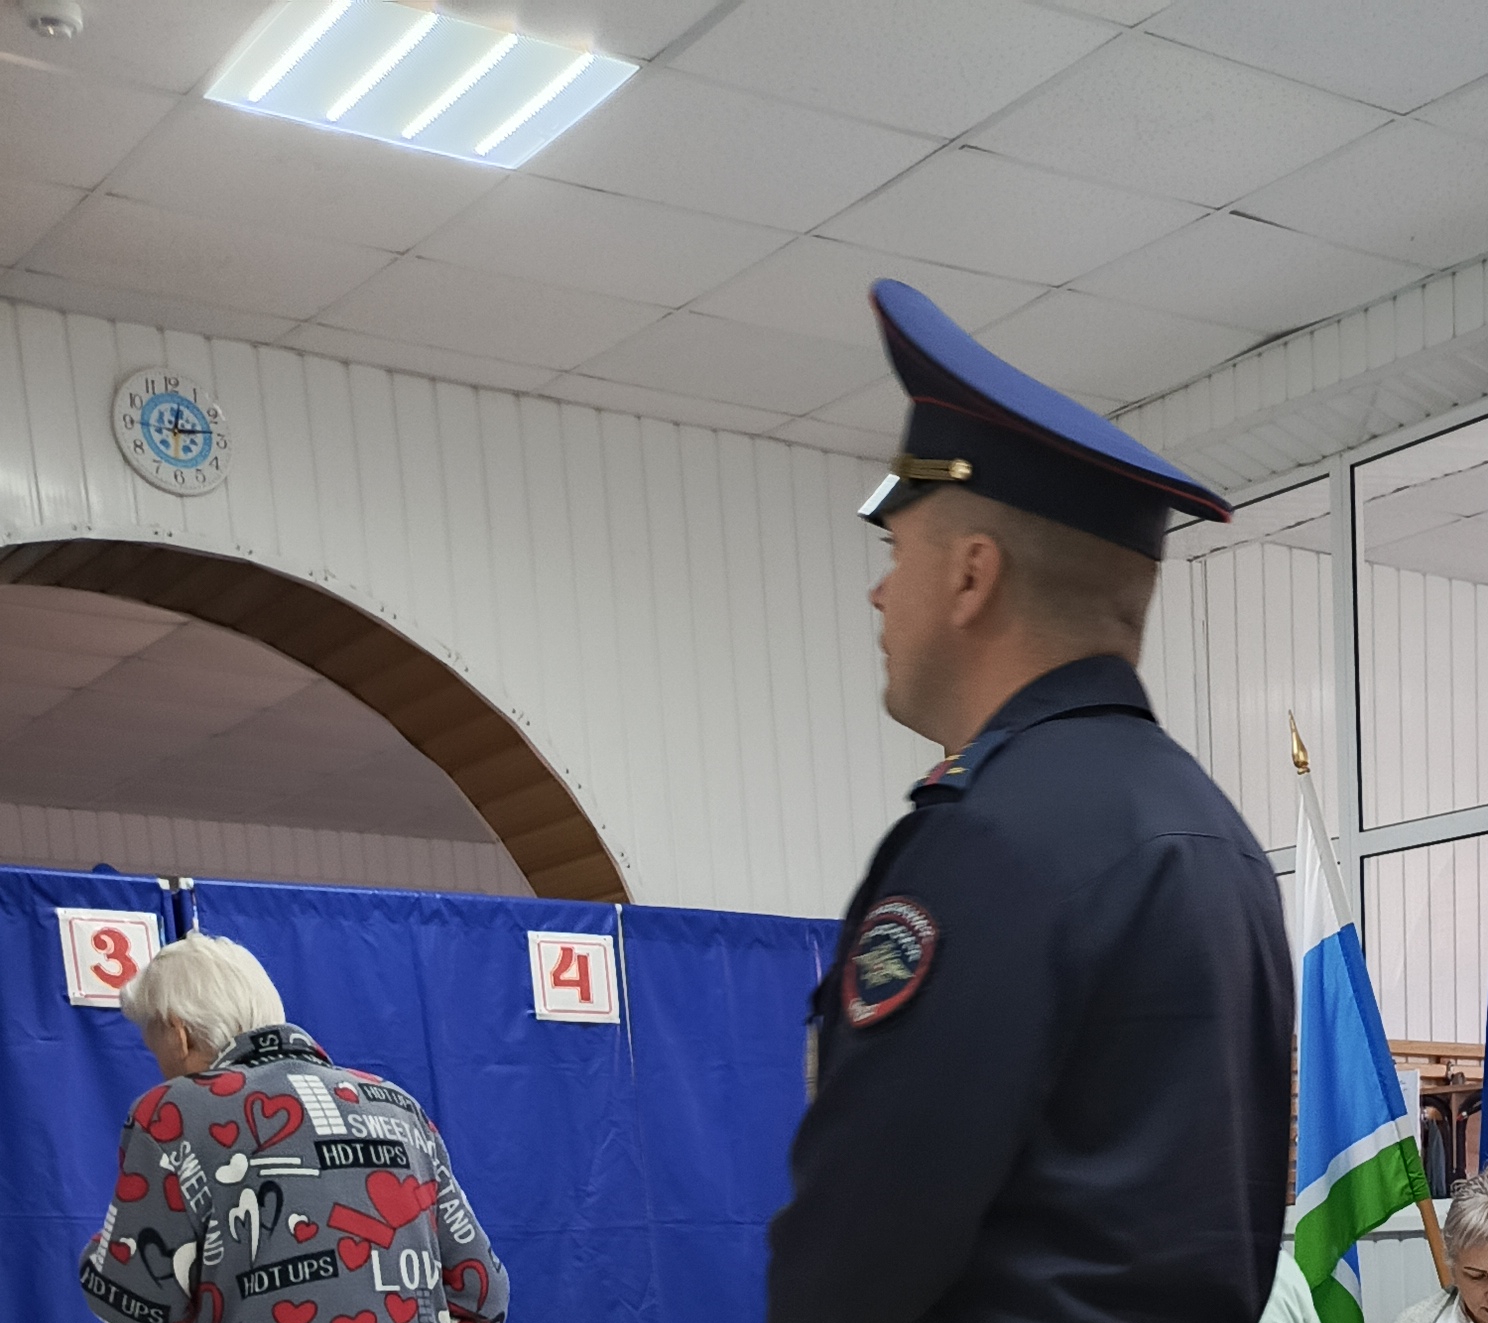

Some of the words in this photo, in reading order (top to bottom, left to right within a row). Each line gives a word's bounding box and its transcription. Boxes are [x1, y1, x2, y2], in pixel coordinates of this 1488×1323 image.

[145, 377, 156, 395] 11
[164, 376, 180, 395] 12
[129, 392, 143, 410] 10
[122, 413, 135, 430] 9
[206, 407, 219, 425] 2
[132, 438, 146, 455] 8
[216, 433, 228, 450] 3
[152, 458, 162, 474] 7
[208, 456, 219, 471] 4
[173, 469, 185, 485] 6
[195, 468, 206, 483] 5
[92, 927, 138, 989] 3
[551, 946, 593, 1003] 4
[369, 1145, 407, 1166] UPS
[288, 1256, 334, 1285] UPS
[371, 1249, 442, 1291] LOV
